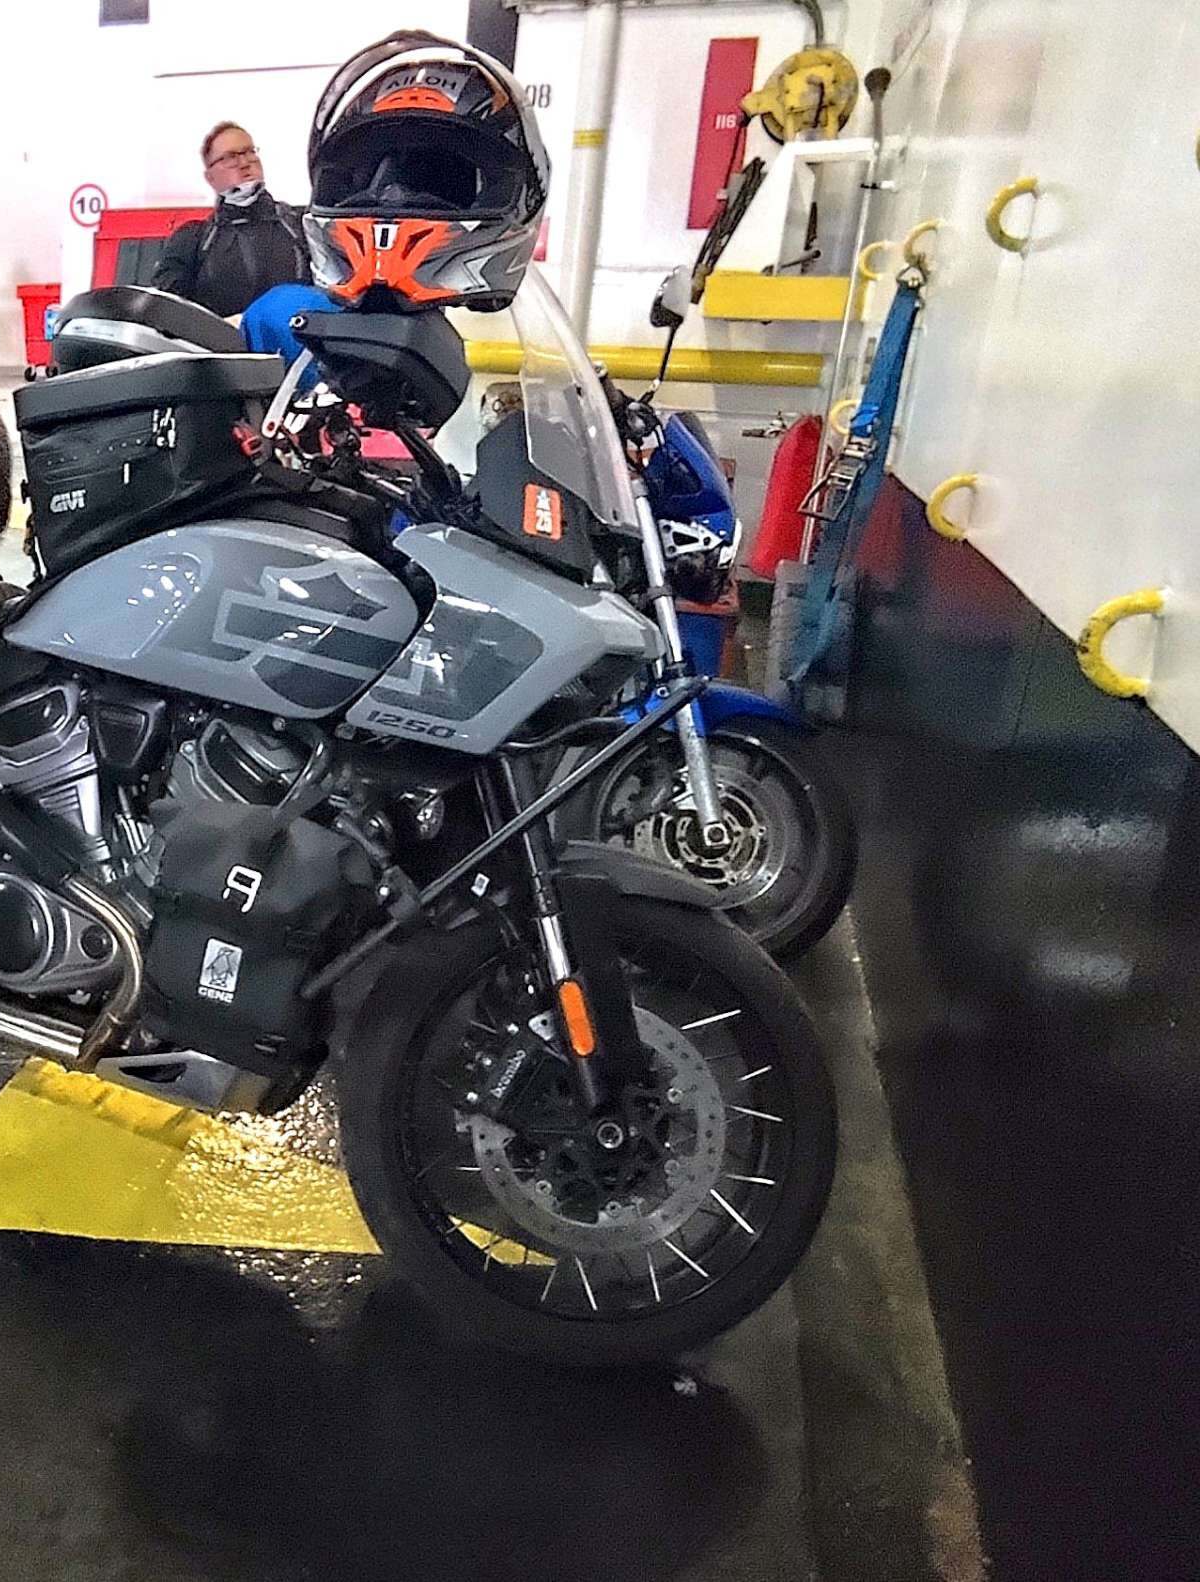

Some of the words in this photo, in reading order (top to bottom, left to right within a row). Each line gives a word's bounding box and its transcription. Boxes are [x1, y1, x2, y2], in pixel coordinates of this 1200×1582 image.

[714, 113, 737, 130] 116
[76, 196, 101, 214] 10
[366, 710, 457, 739] 1250
